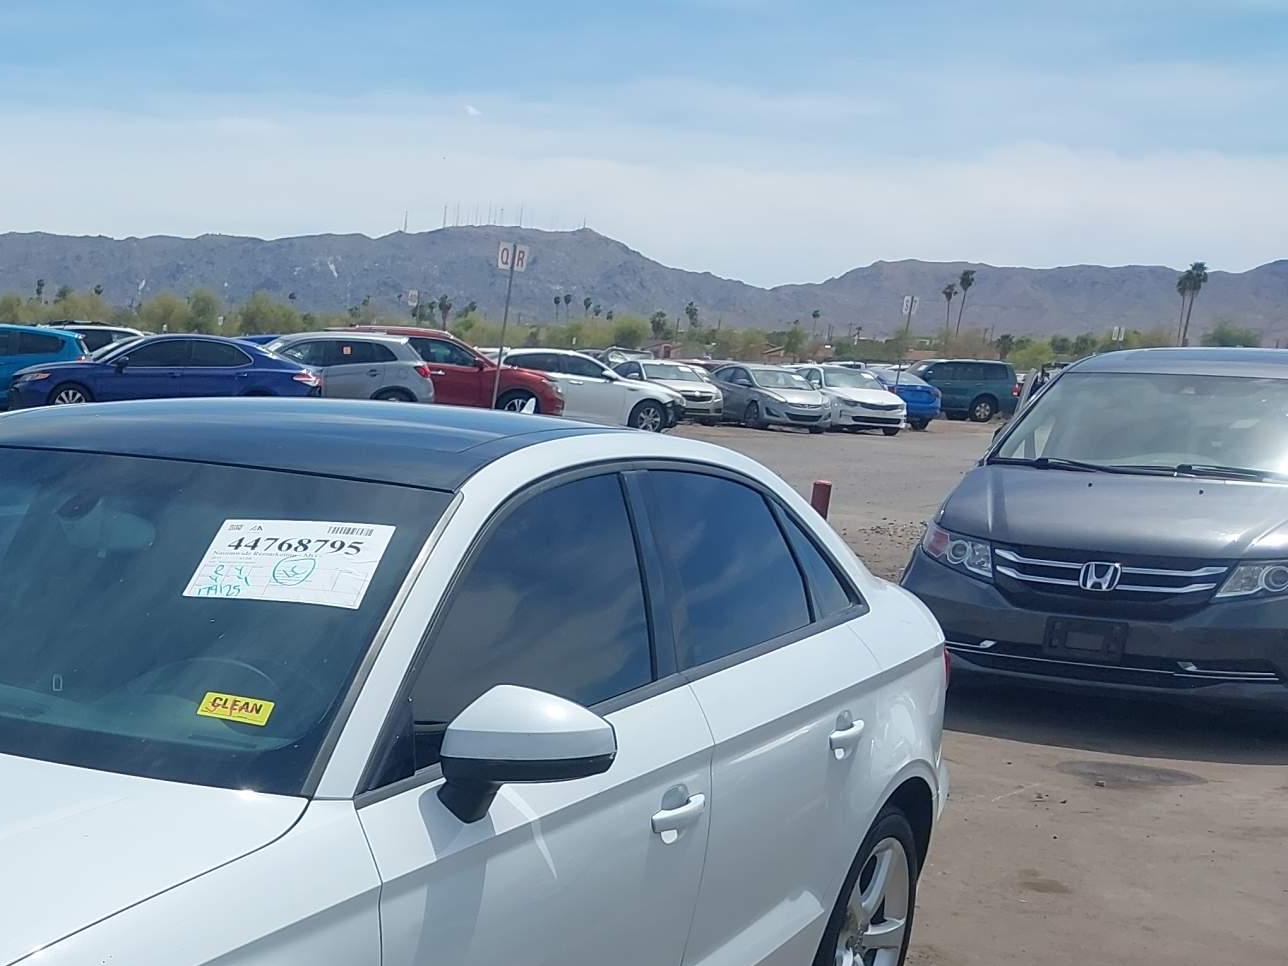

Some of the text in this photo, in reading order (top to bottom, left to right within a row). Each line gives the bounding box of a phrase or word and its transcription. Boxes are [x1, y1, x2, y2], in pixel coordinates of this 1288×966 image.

[500, 247, 525, 268] Q R
[227, 536, 364, 556] 44768795
[211, 696, 263, 715] CLEAN
